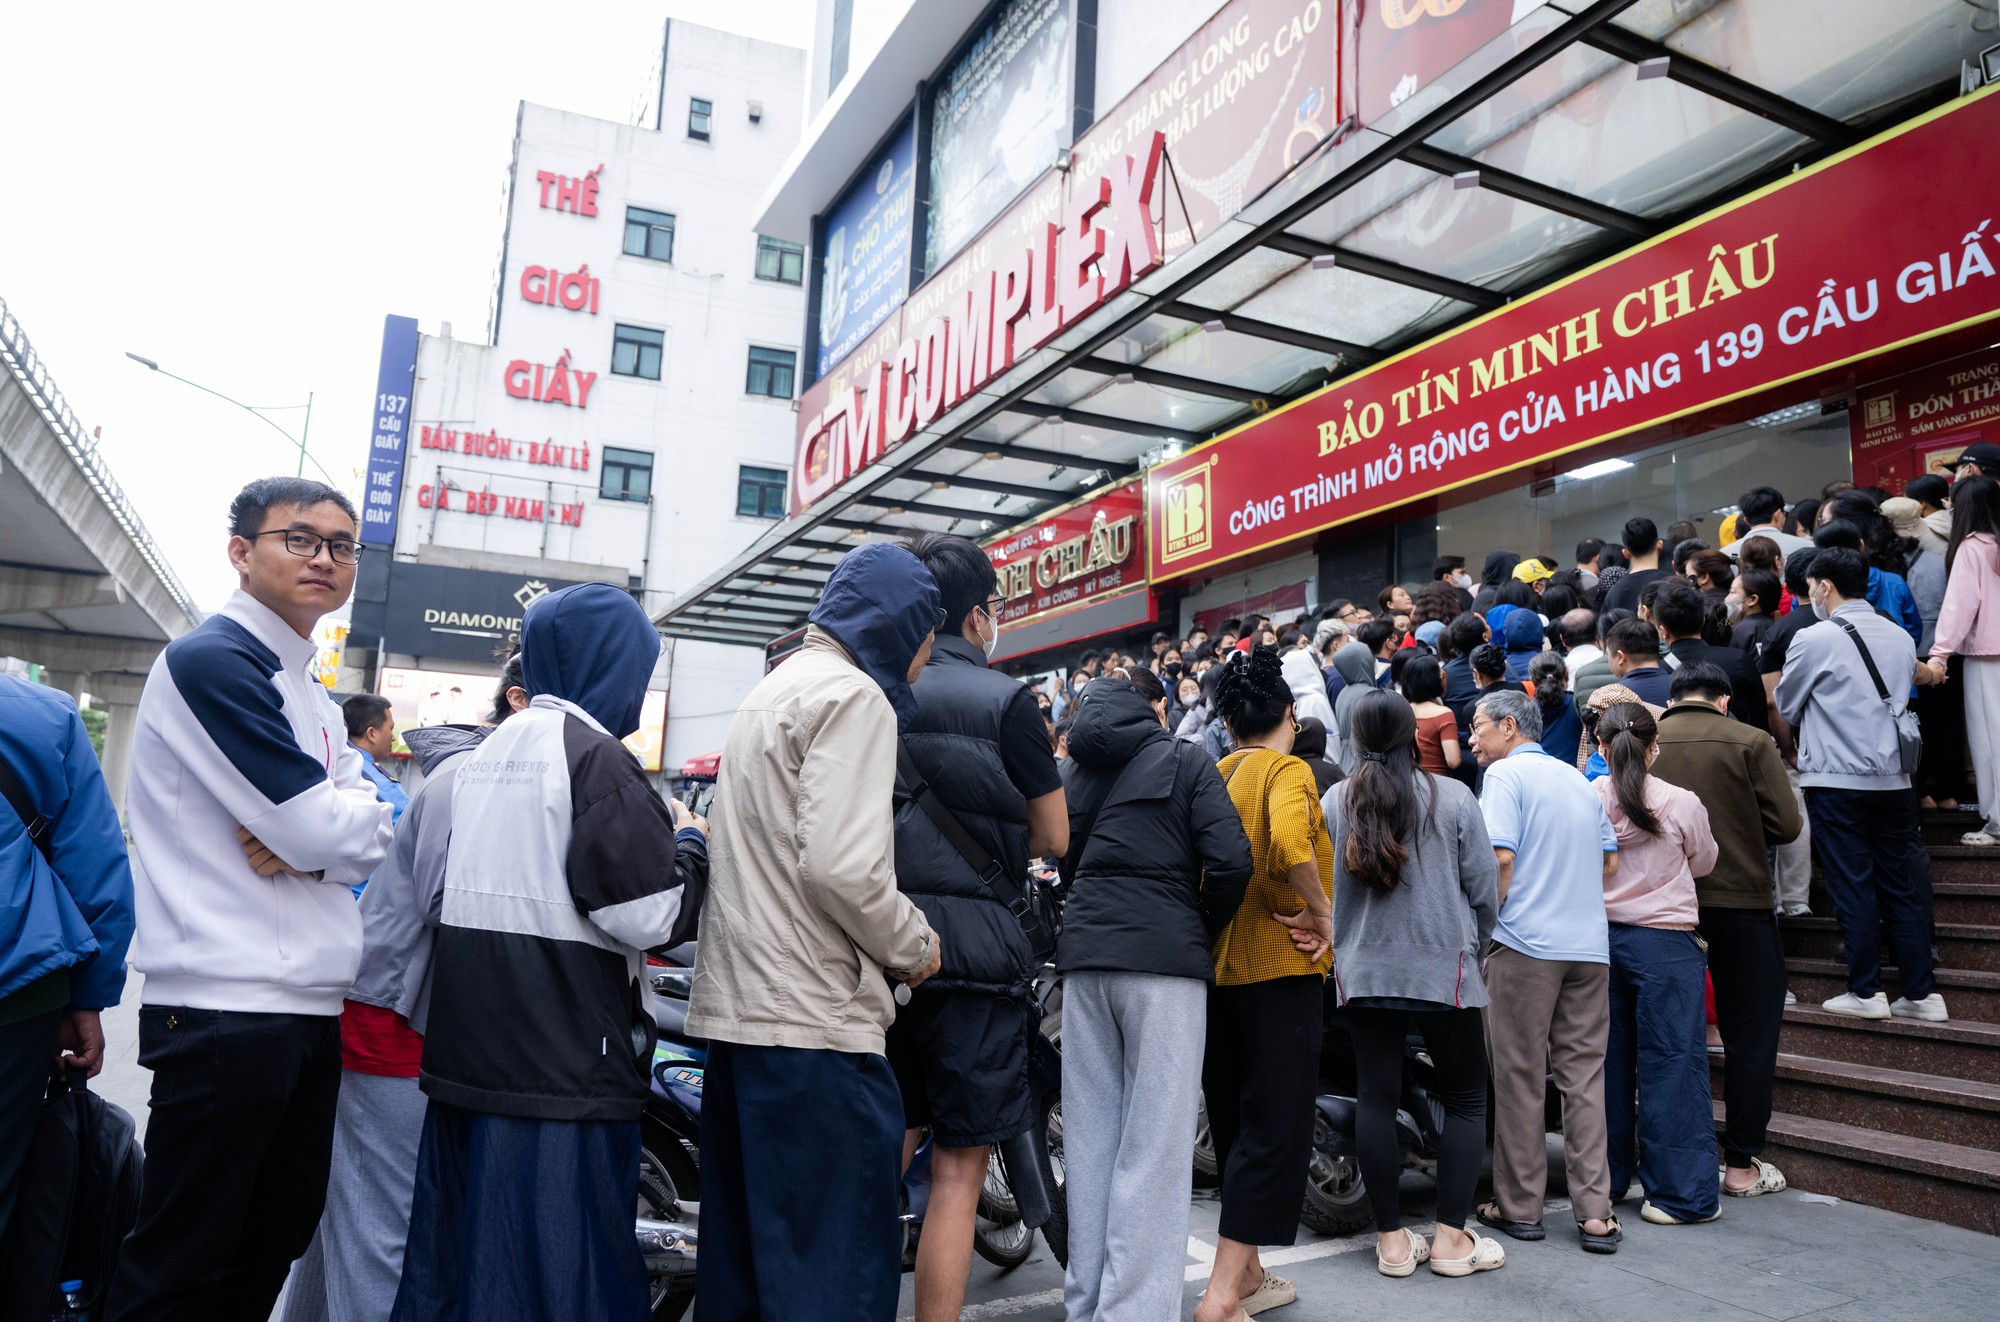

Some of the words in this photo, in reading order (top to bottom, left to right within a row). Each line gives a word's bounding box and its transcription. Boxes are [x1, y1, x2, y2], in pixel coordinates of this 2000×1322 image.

[1163, 95, 1199, 149] HẤT
[1204, 41, 1269, 121] LƯỢNG
[1273, 0, 1322, 59] CAO
[537, 163, 605, 217] THẾ
[909, 285, 945, 326] MINH
[947, 241, 992, 295] CHÂU
[1076, 129, 1122, 187] RỒNG
[1125, 70, 1187, 144] THĂNG
[1191, 14, 1250, 89] LONG
[852, 222, 880, 267] CHO
[520, 264, 600, 314] GIỚI
[885, 130, 1166, 446] COMPLEX
[1317, 399, 1384, 458] BẢO
[1392, 369, 1460, 426] TÍN
[1469, 307, 1602, 398] MINH
[1612, 242, 1780, 339] CHÂU
[504, 348, 597, 408] GIẦY
[1229, 496, 1286, 536] CÔNG
[1290, 467, 1357, 515] TRÌNH
[1364, 442, 1404, 490] MỞ
[1409, 421, 1490, 475] RỘNG
[1498, 391, 1567, 442] CỬA
[1575, 353, 1681, 418] HÀNG
[1694, 323, 1764, 375] 139
[1777, 278, 1879, 346] CẦU
[1896, 219, 2000, 305] GIẤ
[1947, 363, 2000, 387] TRANG
[379, 393, 408, 414] 137
[1908, 393, 1954, 420] ĐÓN
[1935, 411, 1967, 430] VÀNG
[420, 421, 457, 451] BÁN
[463, 428, 512, 460] BUÔN
[529, 437, 564, 467] BÁN
[371, 470, 396, 487] THẾ
[466, 485, 498, 515] DÉP
[504, 495, 544, 523] NAM
[995, 555, 1036, 601] NH
[1036, 511, 1136, 589] CHÂU
[1037, 596, 1051, 609] KIM
[1099, 569, 1122, 589] NGHỆ
[424, 608, 522, 633] DIAMOND
